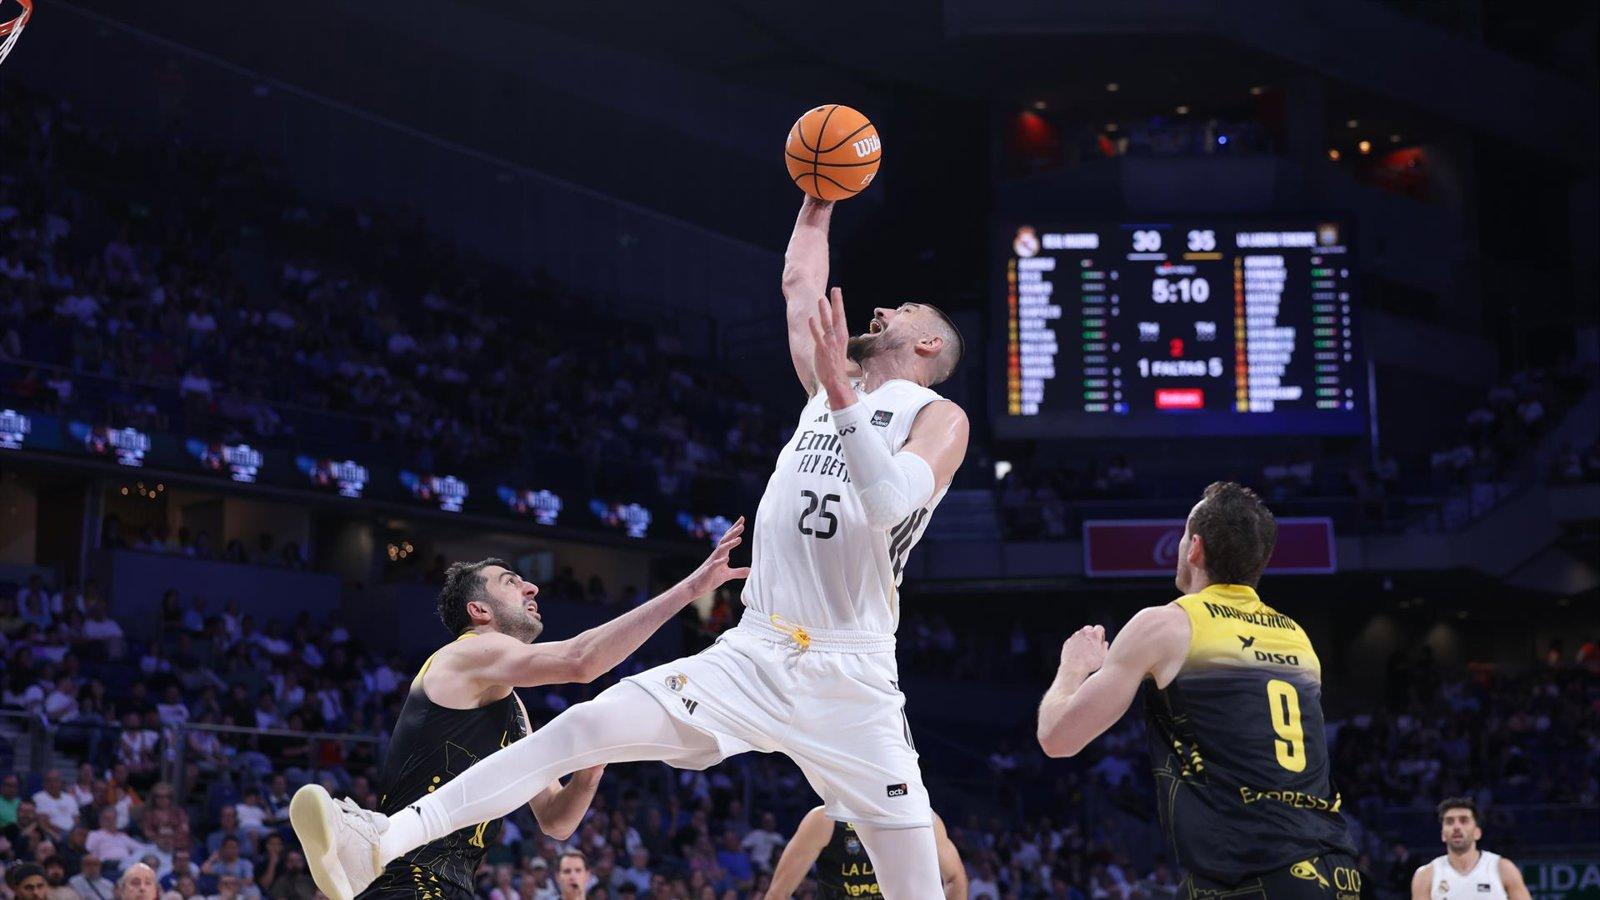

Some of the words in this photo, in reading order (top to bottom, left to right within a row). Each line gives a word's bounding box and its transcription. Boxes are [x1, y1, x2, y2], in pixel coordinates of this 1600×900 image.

[1133, 230, 1162, 252] 30
[1187, 229, 1216, 252] 35
[1152, 278, 1210, 303] 5:10
[1138, 358, 1149, 377] 1
[1208, 357, 1223, 377] 5
[797, 454, 821, 473] FLY
[798, 490, 841, 540] 25
[1266, 679, 1307, 773] 9
[842, 862, 860, 876] LA
[844, 882, 880, 896] tene
